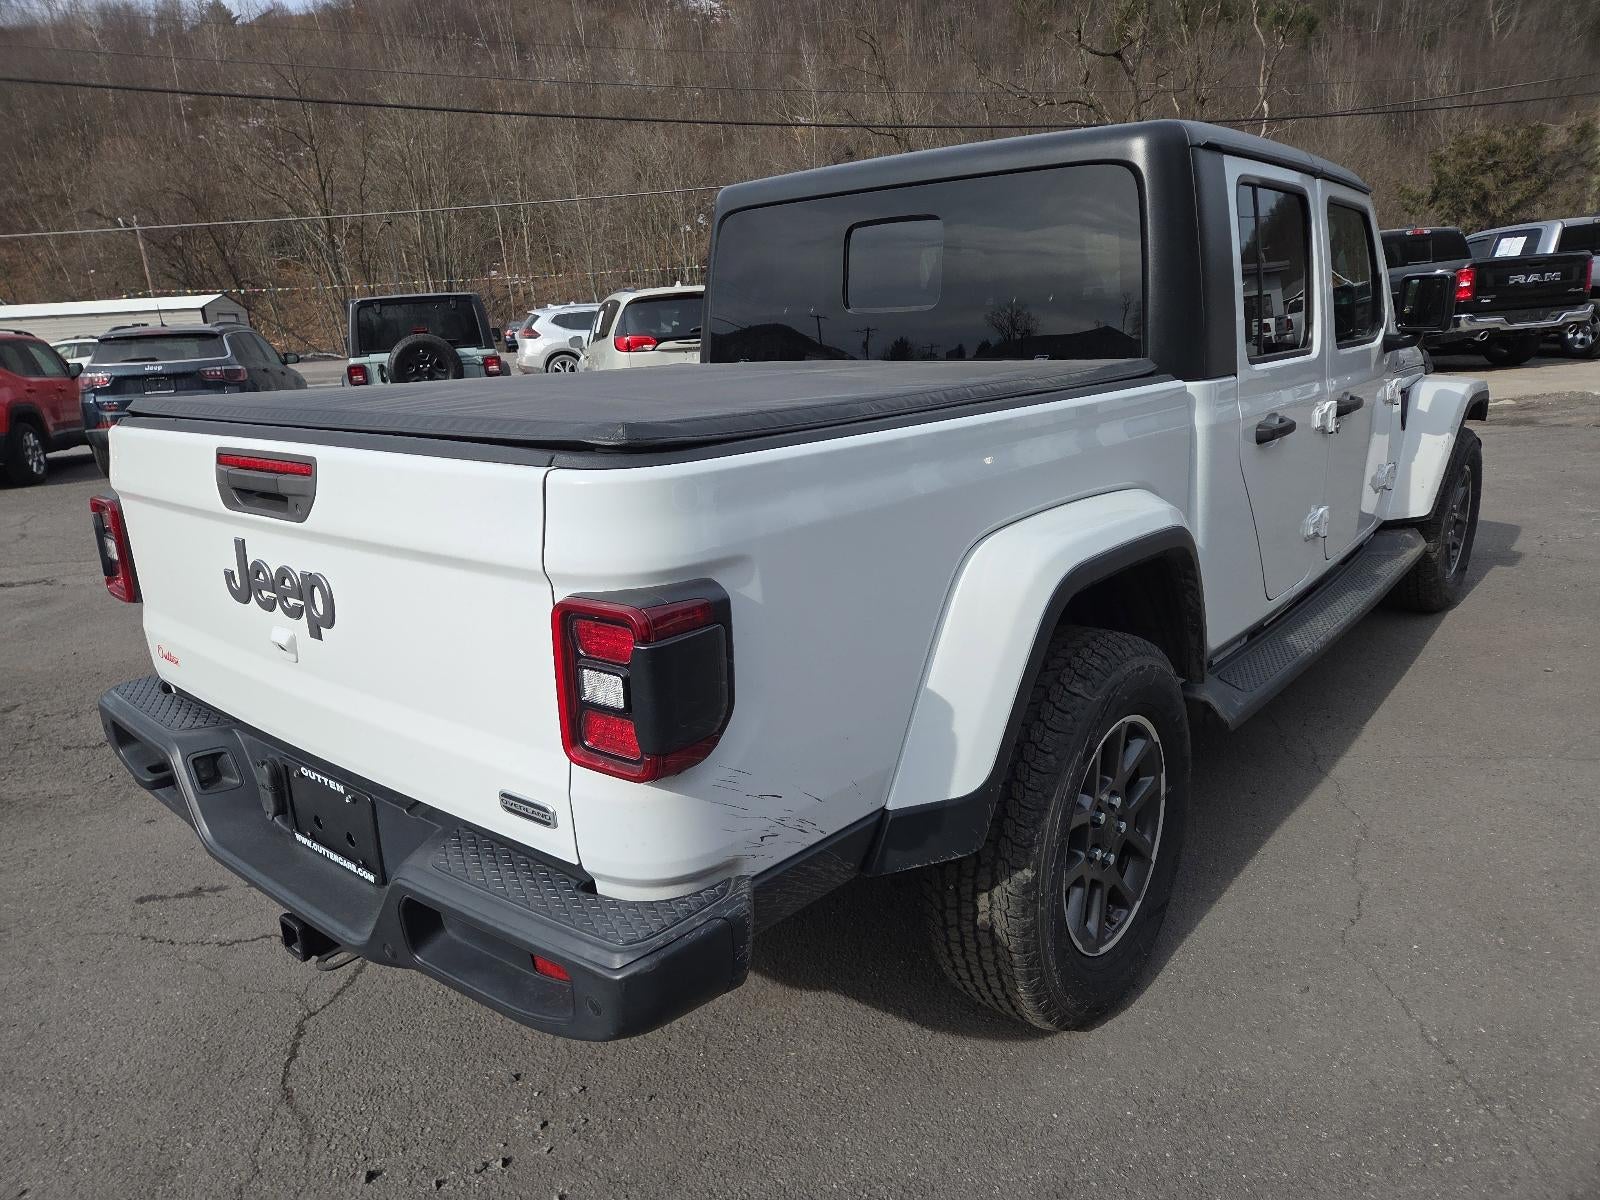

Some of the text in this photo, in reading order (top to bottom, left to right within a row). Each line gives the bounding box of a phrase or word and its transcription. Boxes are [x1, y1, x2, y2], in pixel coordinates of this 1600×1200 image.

[1508, 271, 1561, 285] RAM
[223, 536, 335, 641] Jeep
[300, 766, 345, 794] OUTTEN
[500, 797, 552, 823] OVERLAND
